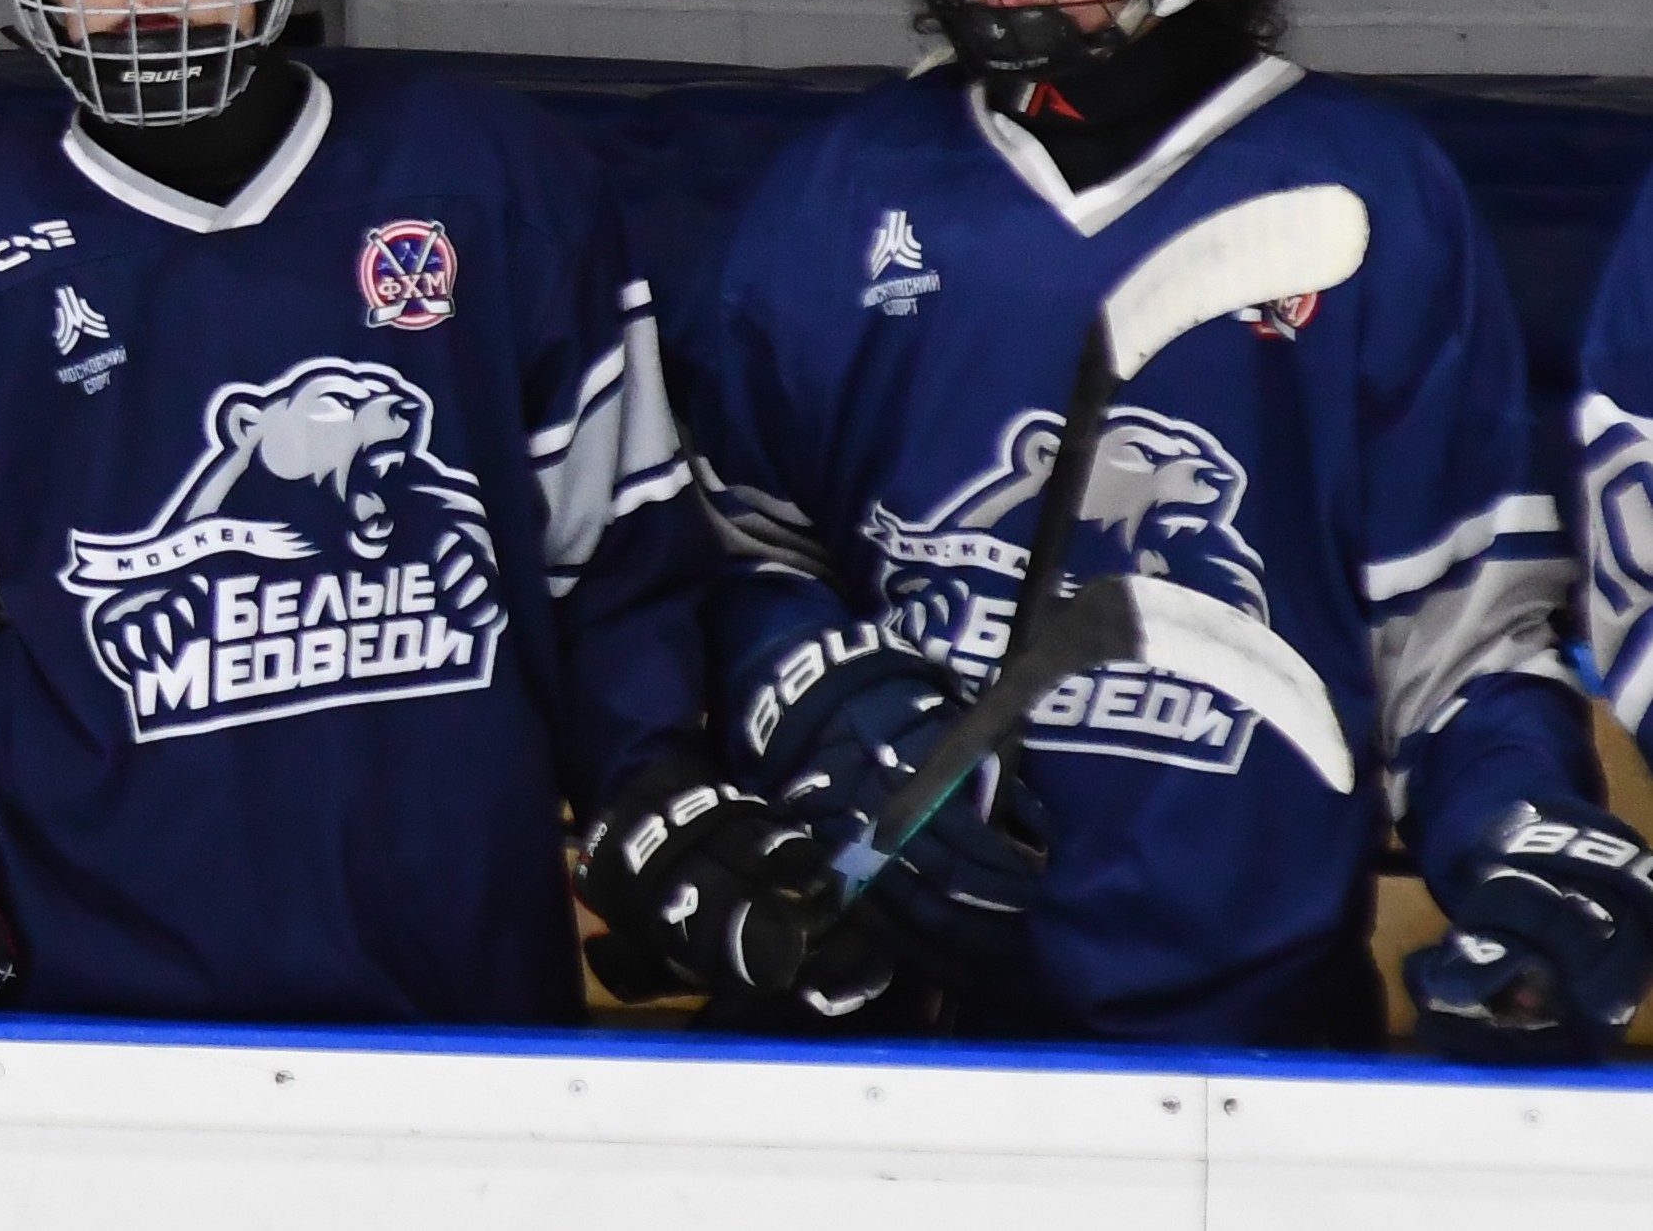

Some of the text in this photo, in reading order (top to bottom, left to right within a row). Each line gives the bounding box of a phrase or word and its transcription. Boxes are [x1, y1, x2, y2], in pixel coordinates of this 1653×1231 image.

[378, 272, 448, 301] ФХМ
[116, 527, 257, 573] МОСКВА
[216, 562, 436, 643] БЕЛЫЕ
[136, 616, 475, 717] МЕДВЕДИ
